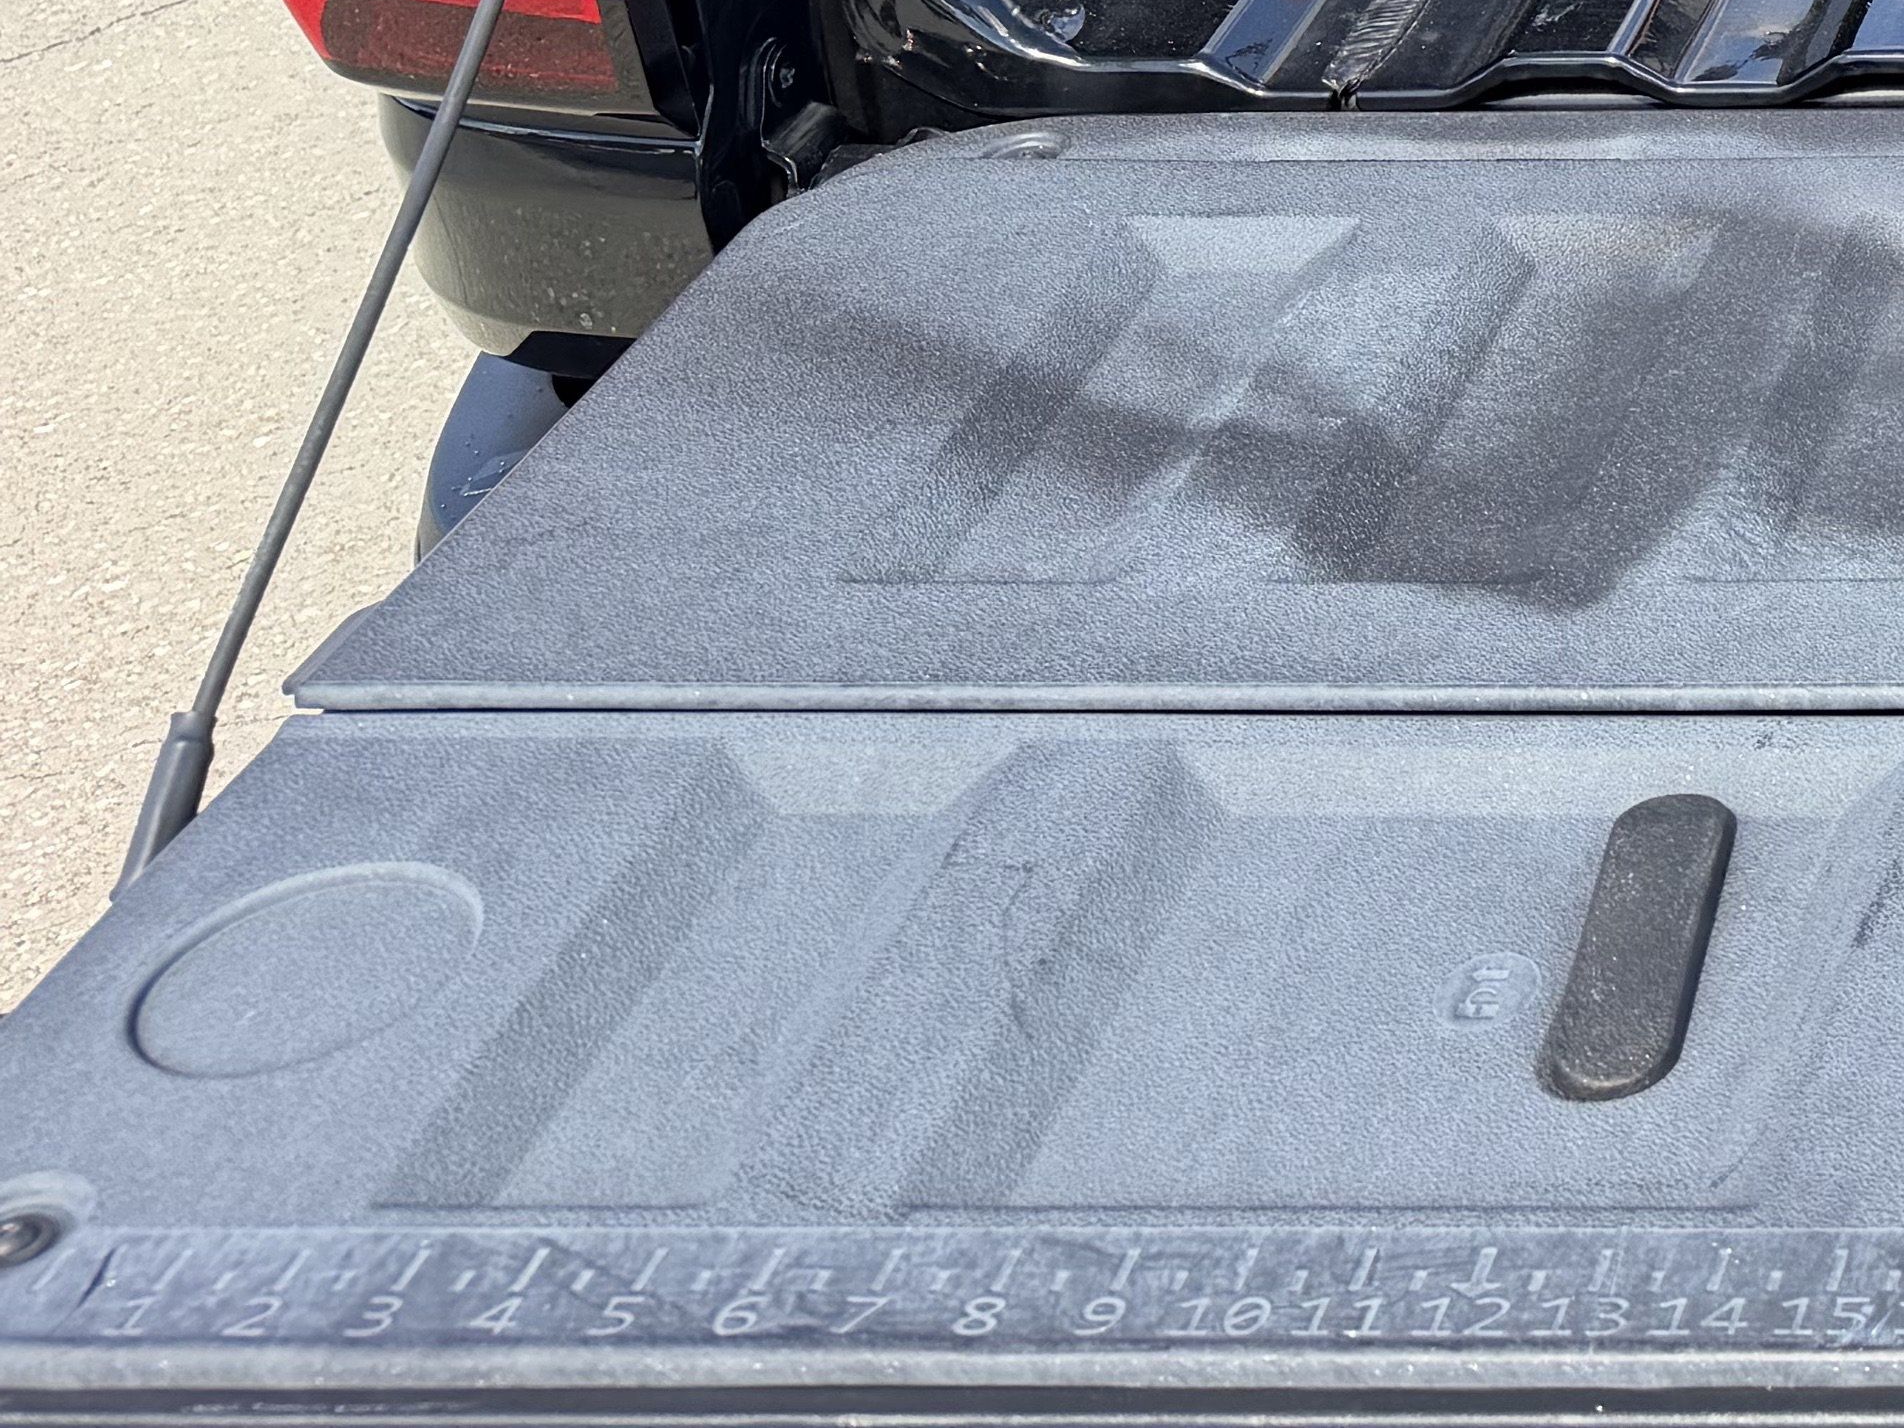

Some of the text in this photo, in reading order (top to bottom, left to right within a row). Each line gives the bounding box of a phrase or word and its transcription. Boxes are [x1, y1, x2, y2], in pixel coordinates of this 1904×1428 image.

[100, 1296, 150, 1336] 1
[223, 1296, 284, 1336] 2
[344, 1296, 403, 1336] 3
[470, 1296, 517, 1336] 4
[586, 1296, 644, 1336] 5
[712, 1296, 767, 1336] 6
[831, 1296, 889, 1336] 7
[951, 1296, 1006, 1336] 8
[1073, 1296, 1127, 1335] 9
[1165, 1296, 1273, 1335] 10
[1290, 1296, 1383, 1335] 11
[1410, 1296, 1507, 1335] 12
[1529, 1296, 1626, 1335] 13
[1653, 1296, 1750, 1335] 14
[1772, 1296, 1872, 1335] 15
